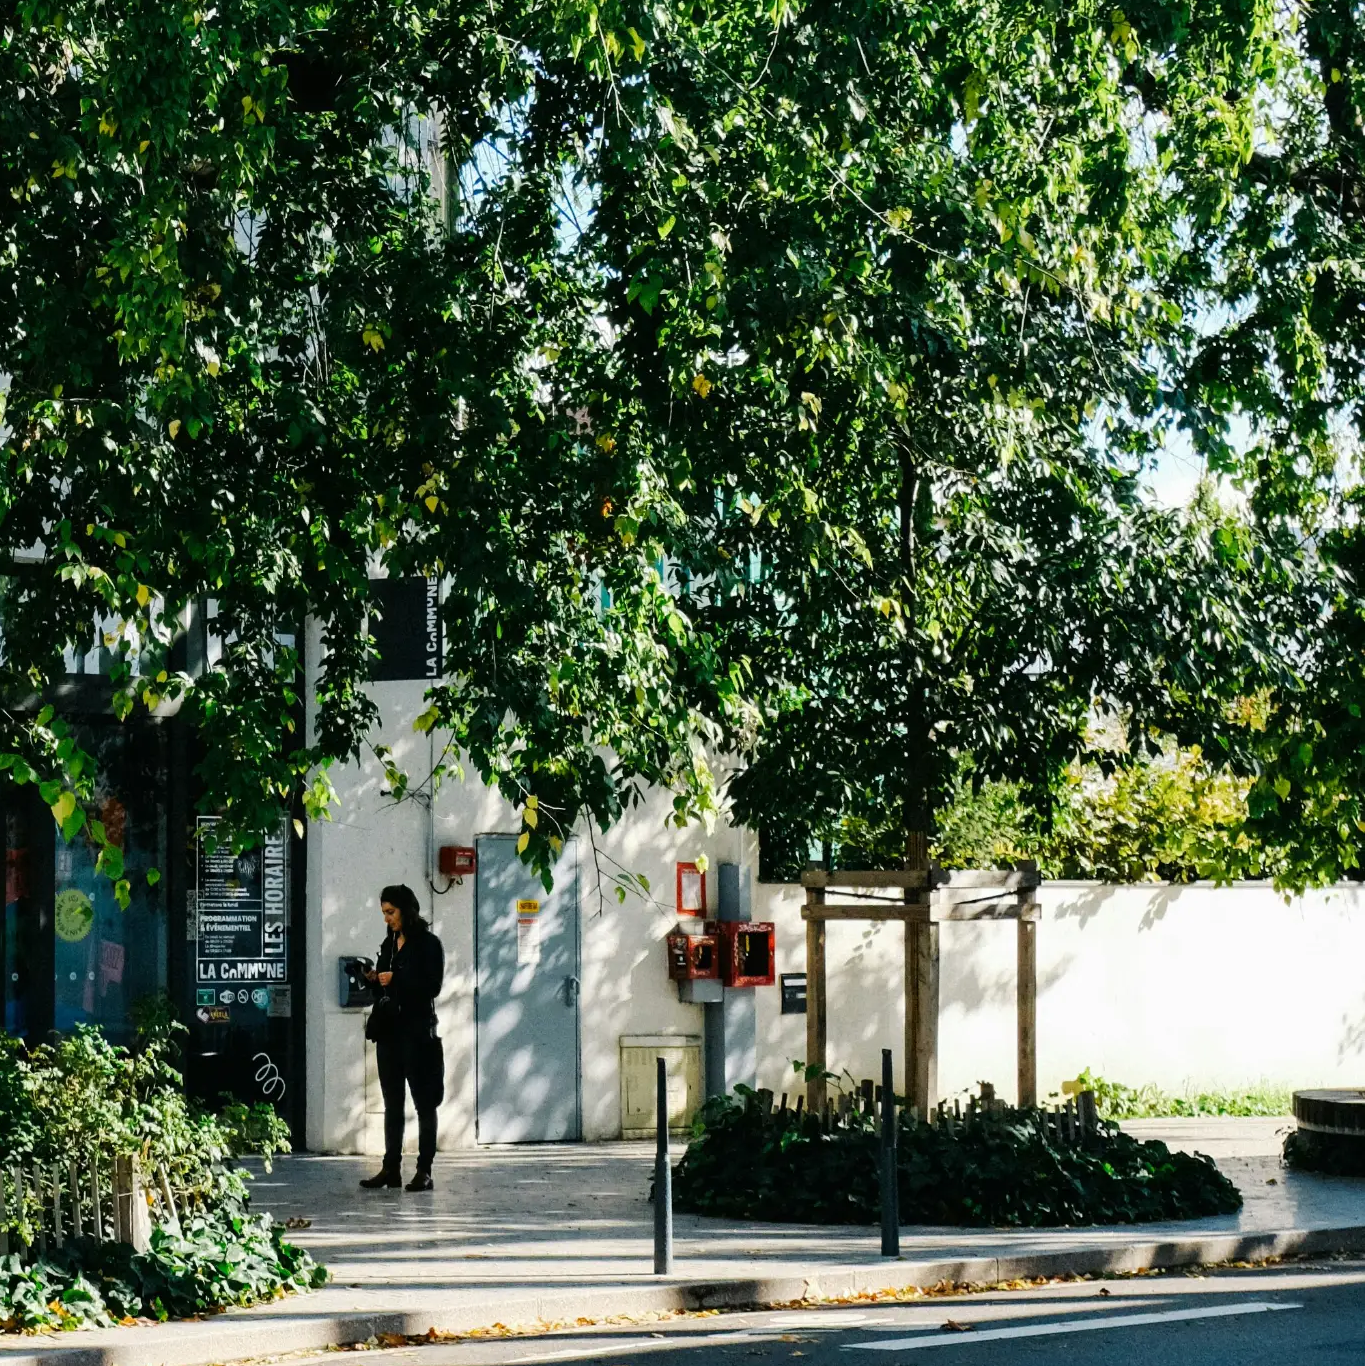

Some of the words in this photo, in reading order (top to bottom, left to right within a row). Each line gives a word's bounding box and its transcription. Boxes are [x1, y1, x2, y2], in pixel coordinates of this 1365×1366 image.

[426, 657, 437, 676] LA
[264, 921, 284, 954] LES
[199, 962, 217, 979] LA
